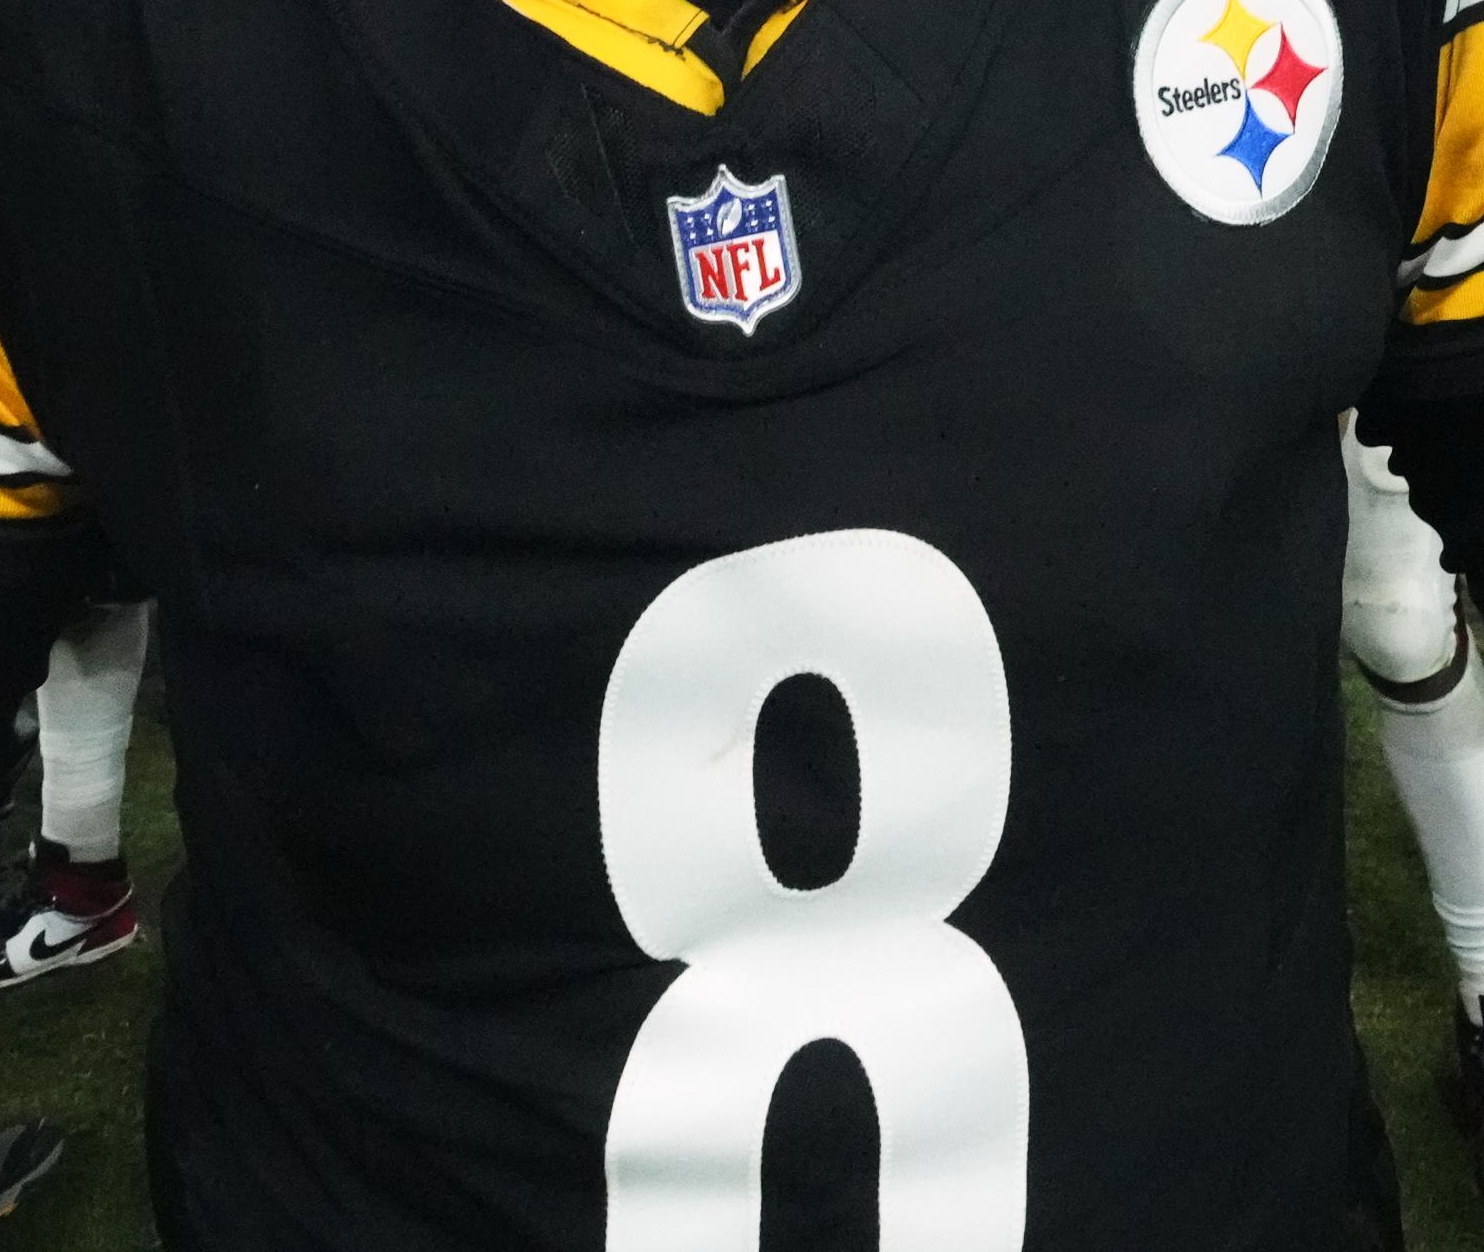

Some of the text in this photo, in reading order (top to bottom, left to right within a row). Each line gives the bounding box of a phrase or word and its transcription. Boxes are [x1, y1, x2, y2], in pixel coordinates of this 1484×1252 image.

[1157, 77, 1242, 117] Steelers
[695, 238, 781, 302] NFL
[598, 528, 1030, 1252] 8
